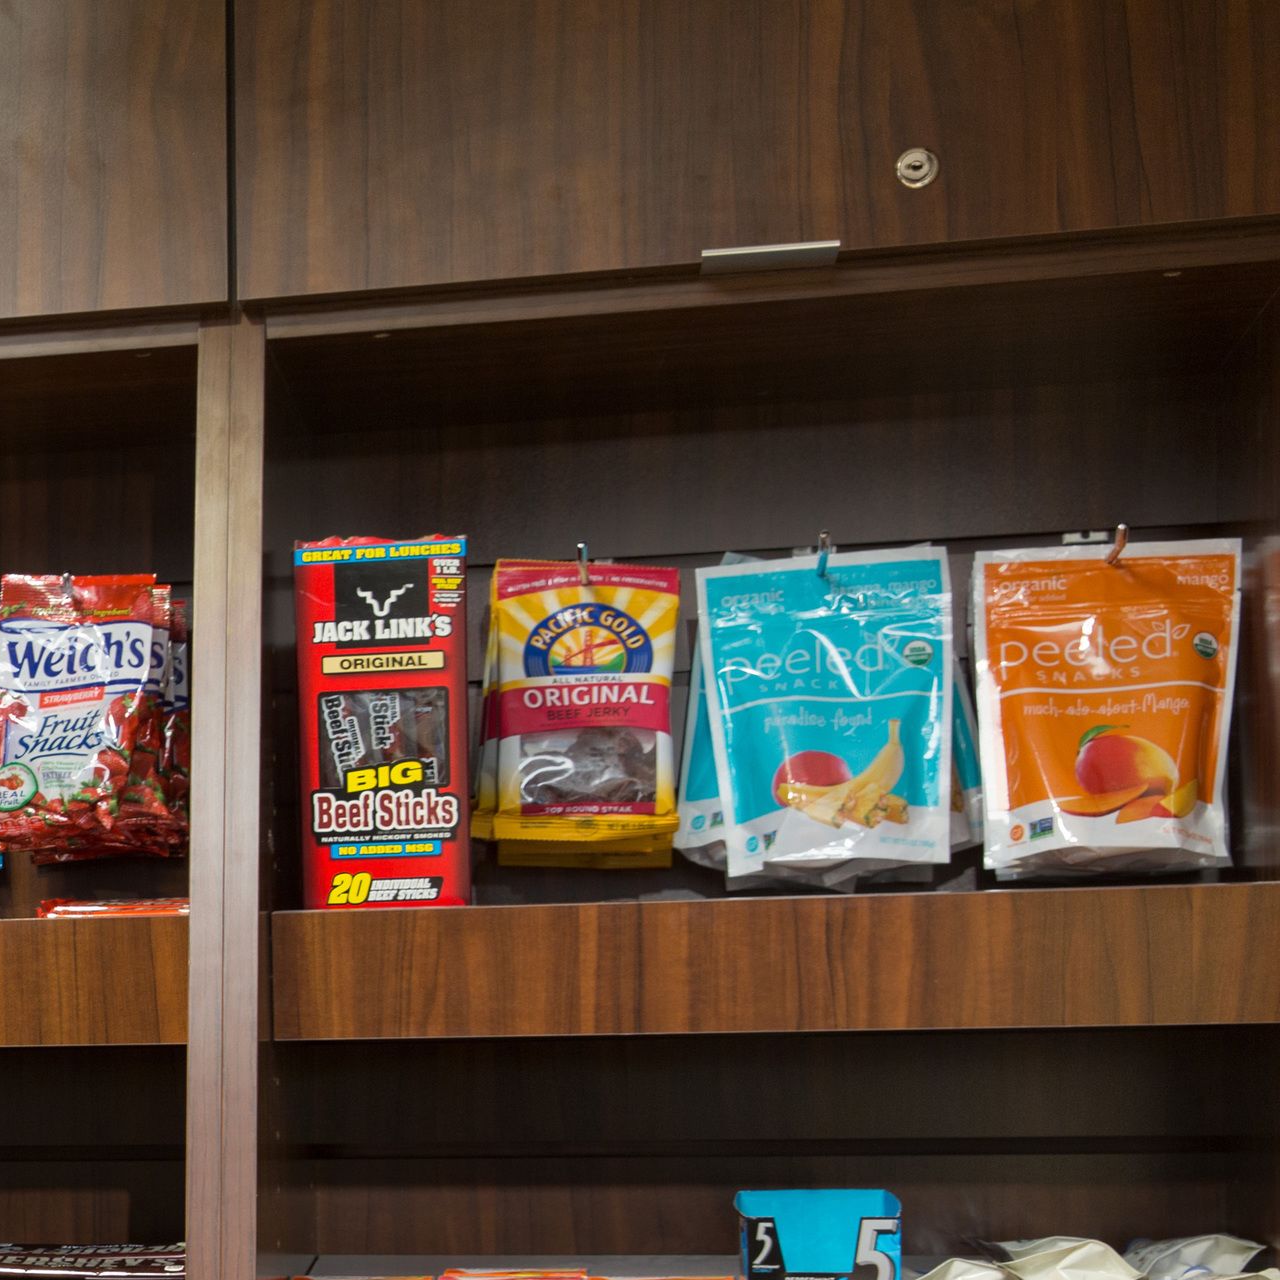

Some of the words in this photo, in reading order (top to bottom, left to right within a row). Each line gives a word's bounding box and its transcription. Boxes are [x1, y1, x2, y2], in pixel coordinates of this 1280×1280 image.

[302, 550, 352, 562] GREAT
[356, 548, 385, 559] FOR
[389, 543, 461, 557] LUNCHES
[433, 559, 460, 567] OVER
[998, 576, 1067, 595] organic
[1177, 572, 1230, 590] mango
[720, 588, 785, 610] organic
[313, 620, 371, 643] JACK
[375, 614, 452, 640] LINK'S
[530, 607, 595, 650] PACIFIC
[599, 610, 644, 649] GOLD
[7, 631, 146, 682] Welch's
[999, 619, 1172, 681] peeled
[340, 656, 427, 670] ORIGINAL
[723, 635, 885, 695] peeled
[52, 676, 87, 685] FARMER
[552, 676, 571, 684] ALL
[575, 675, 624, 683] NATURAL
[323, 695, 347, 736] Beef
[371, 700, 392, 749] Stick
[586, 706, 630, 718] JERKY
[14, 731, 104, 760] Snacks
[347, 761, 423, 793] BIG
[315, 792, 373, 831] Beef
[378, 789, 458, 831] Sticks
[339, 847, 357, 856] NO
[360, 845, 402, 855] ADDED
[405, 844, 434, 853] MSG
[327, 873, 372, 905] 20
[368, 889, 396, 901] BEEF
[398, 888, 439, 900] STICKS
[371, 878, 432, 890] INDIVIDUAL
[752, 1222, 773, 1265] 5
